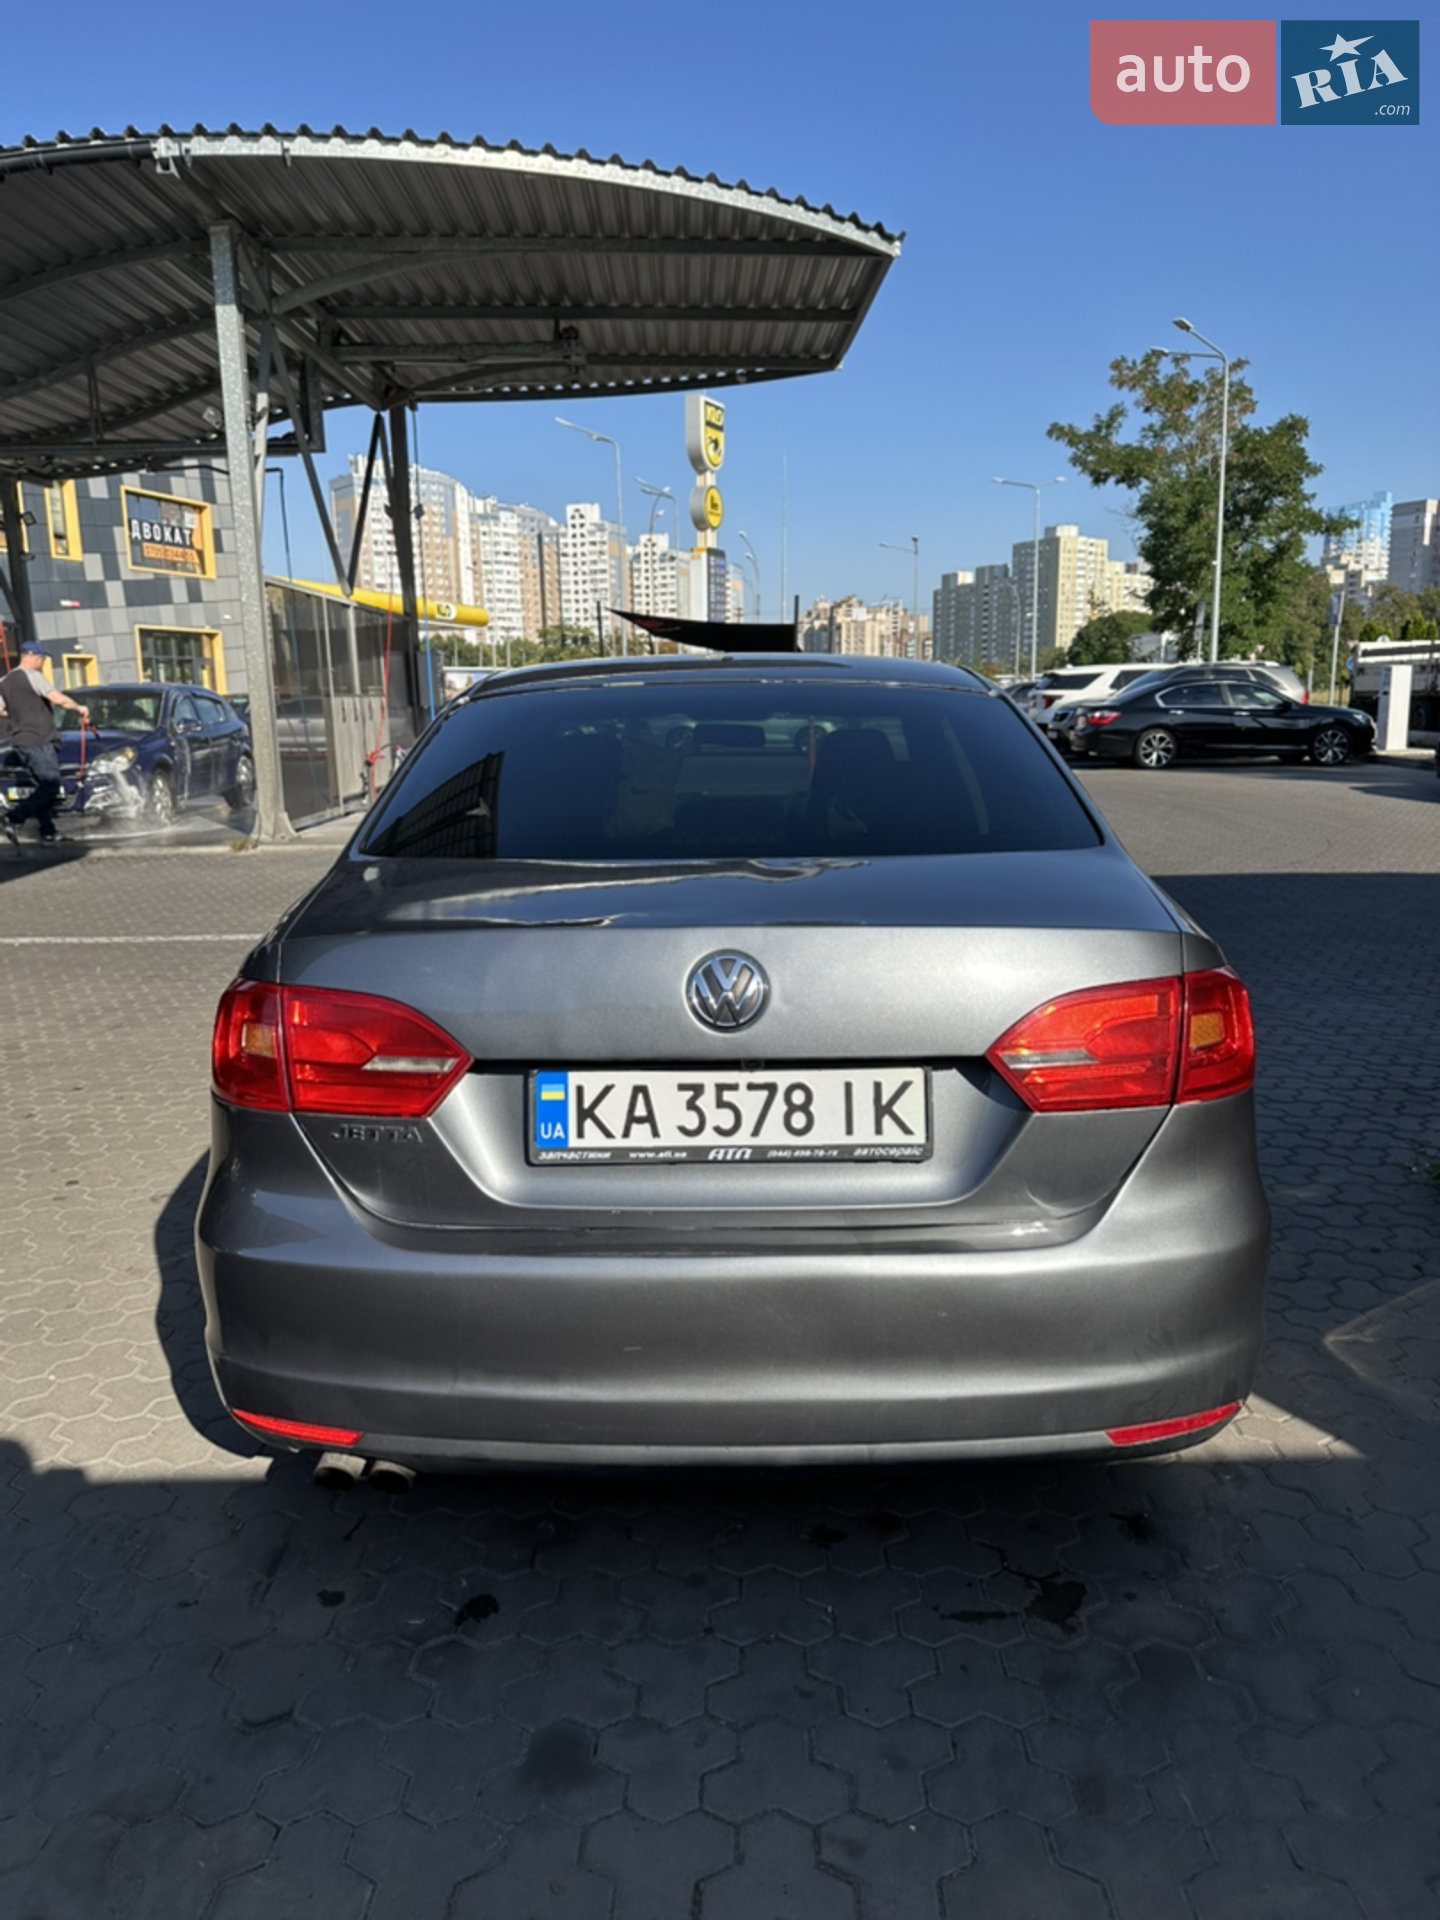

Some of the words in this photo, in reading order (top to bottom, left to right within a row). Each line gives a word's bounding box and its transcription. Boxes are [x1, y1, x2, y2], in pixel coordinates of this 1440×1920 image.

[575, 1083, 661, 1139] KA
[676, 1081, 815, 1138] 3578
[844, 1080, 915, 1137] IK
[330, 1123, 423, 1143] JETTA
[540, 1122, 566, 1139] UA
